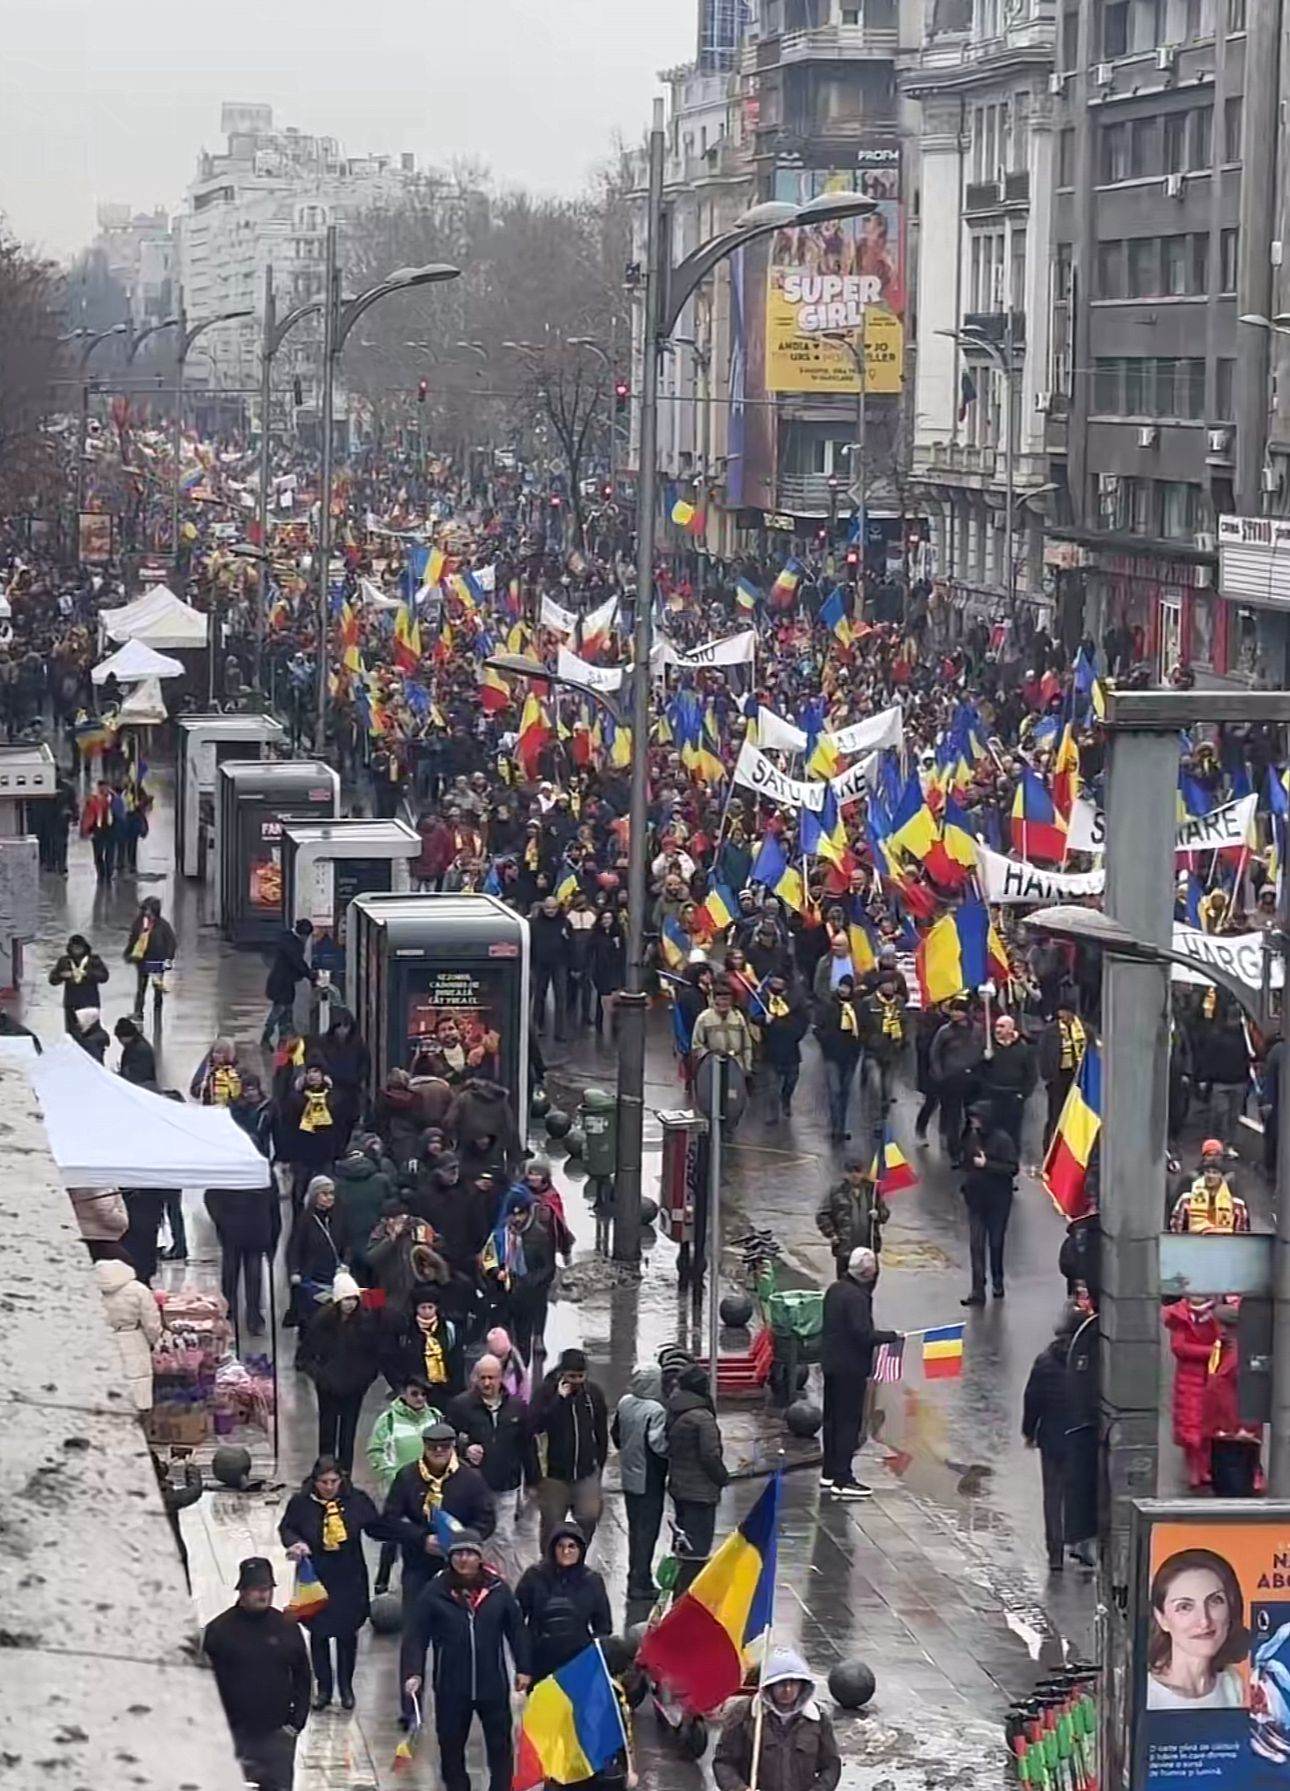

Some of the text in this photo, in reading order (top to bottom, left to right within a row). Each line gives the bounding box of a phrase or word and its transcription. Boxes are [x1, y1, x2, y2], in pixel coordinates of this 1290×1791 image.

[783, 274, 882, 304] SUPER
[796, 299, 863, 332] GIRL
[752, 759, 868, 807] SATU MRE
[1273, 1552, 1290, 1569] N
